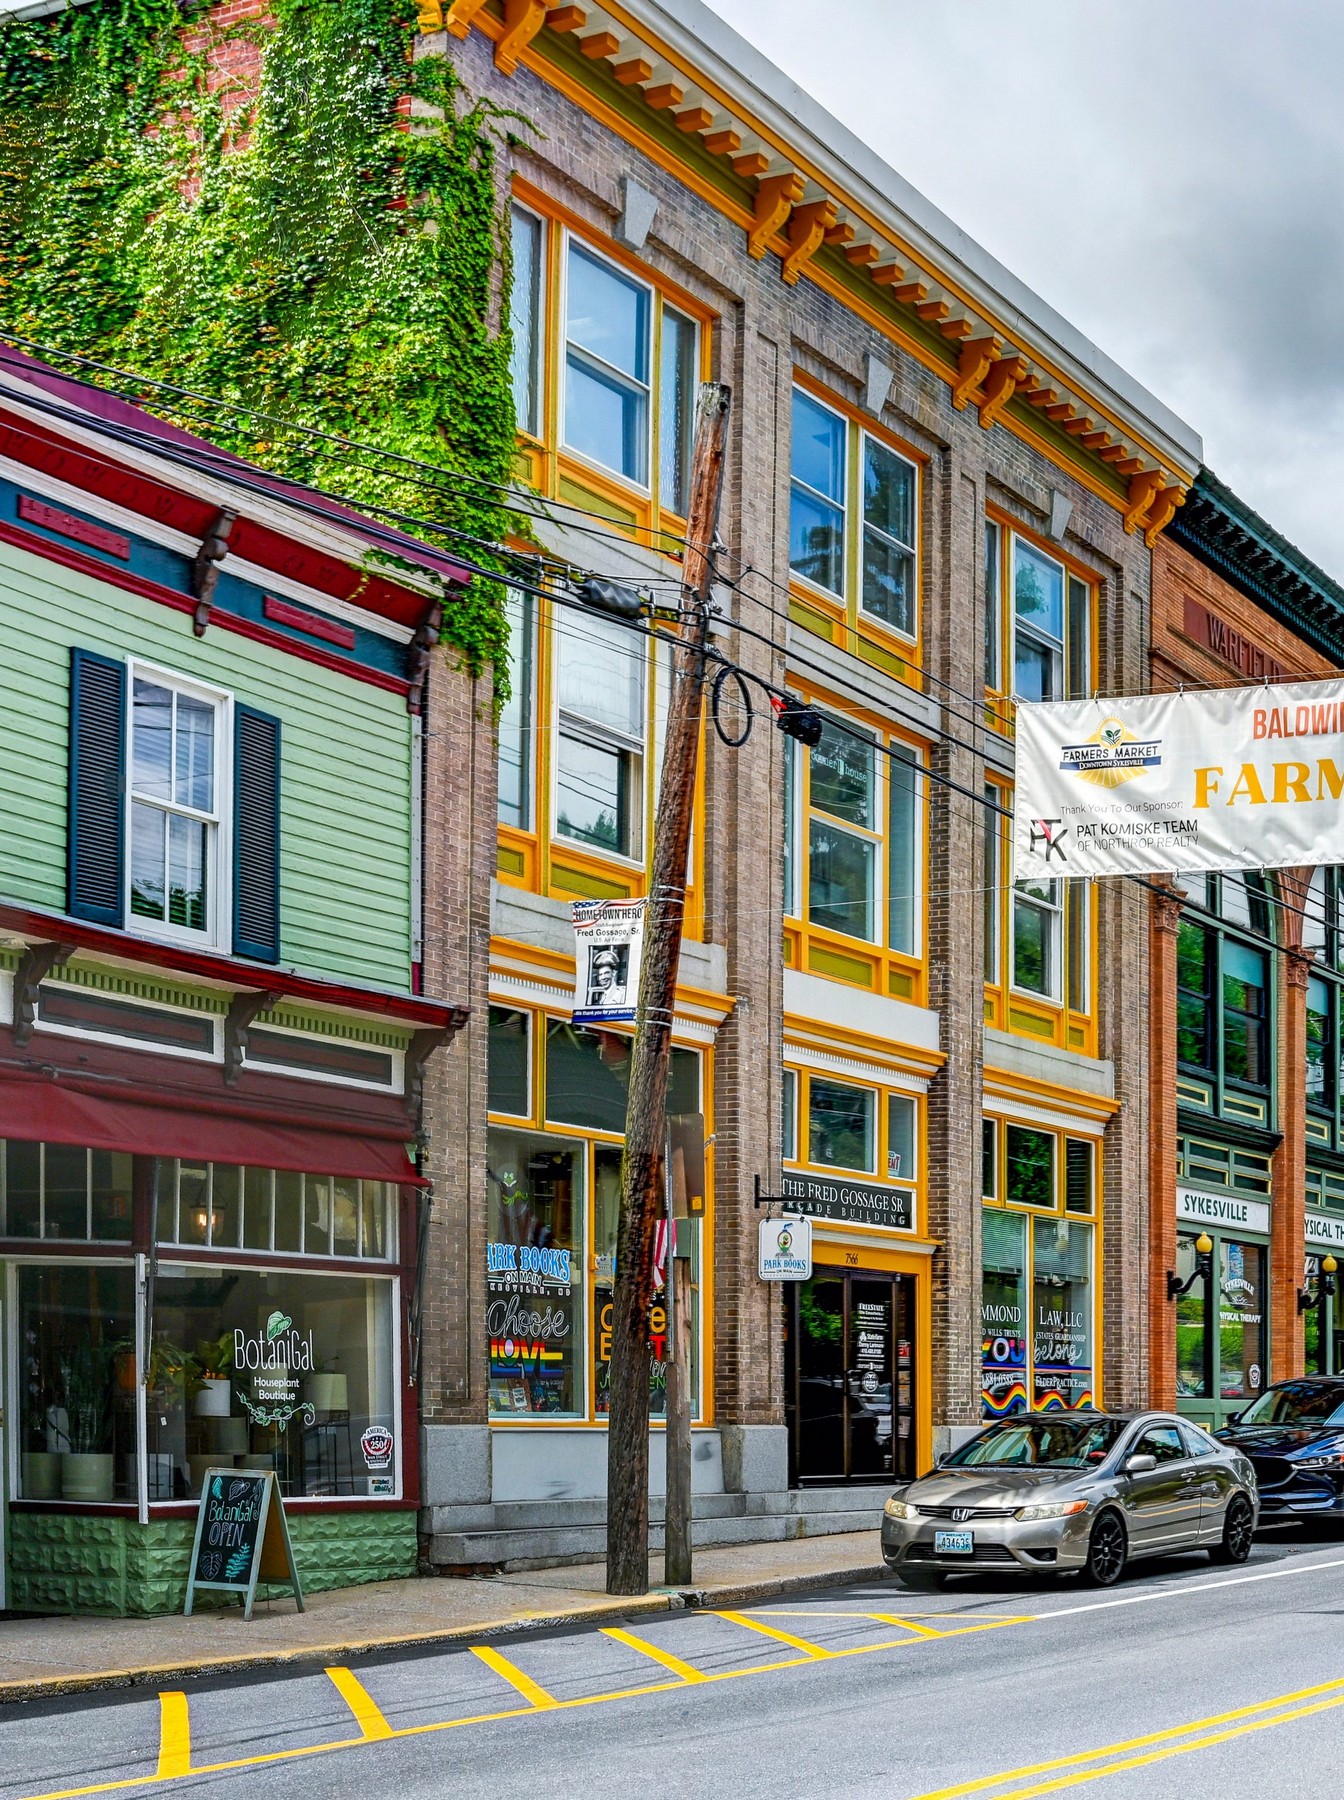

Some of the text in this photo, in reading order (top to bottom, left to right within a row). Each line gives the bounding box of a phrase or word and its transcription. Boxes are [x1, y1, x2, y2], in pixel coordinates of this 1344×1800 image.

[1063, 745, 1158, 761] FARMERS MARKET
[1079, 760, 1112, 769] DOWNTOWN
[1060, 801, 1183, 815] Thank You To Our Sponsor:
[1077, 819, 1198, 837] PAT KOMISKE TEAM
[1077, 835, 1199, 851] OF NORTHROP REALTY
[575, 908, 642, 920] HOMETOWN HERO
[807, 1183, 838, 1203] FRED
[840, 1188, 890, 1210] GOSSAGE
[891, 1196, 904, 1213] SR
[841, 1207, 906, 1225] BUILDING
[1184, 1194, 1248, 1222] SYKESVILLE
[1305, 1218, 1333, 1239] YSICAL
[487, 1243, 571, 1283] ARK BOOKS
[763, 1259, 807, 1271] PARK BOOKS
[504, 1271, 542, 1287] ON MAIN
[1224, 1278, 1255, 1296] SYKESVILLE
[490, 1283, 550, 1296] KESVILLE,
[487, 1294, 569, 1339] Choose
[1065, 1311, 1083, 1327] LLC
[1240, 1313, 1262, 1323] THERAPY
[988, 1328, 1002, 1337] WILLS
[1004, 1329, 1021, 1338] TRUSTS
[1035, 1332, 1053, 1340] ESTATES
[1054, 1333, 1086, 1342] GUARDIANSHIP
[234, 1328, 315, 1370] BotaniGal
[1033, 1340, 1082, 1365] belong
[490, 1338, 564, 1379] LOVE
[253, 1377, 300, 1388] Houseplant
[258, 1389, 296, 1401] Boutique
[370, 1440, 384, 1450] 250
[208, 1500, 253, 1522] BotaniGal
[208, 1522, 245, 1547] OPEN
